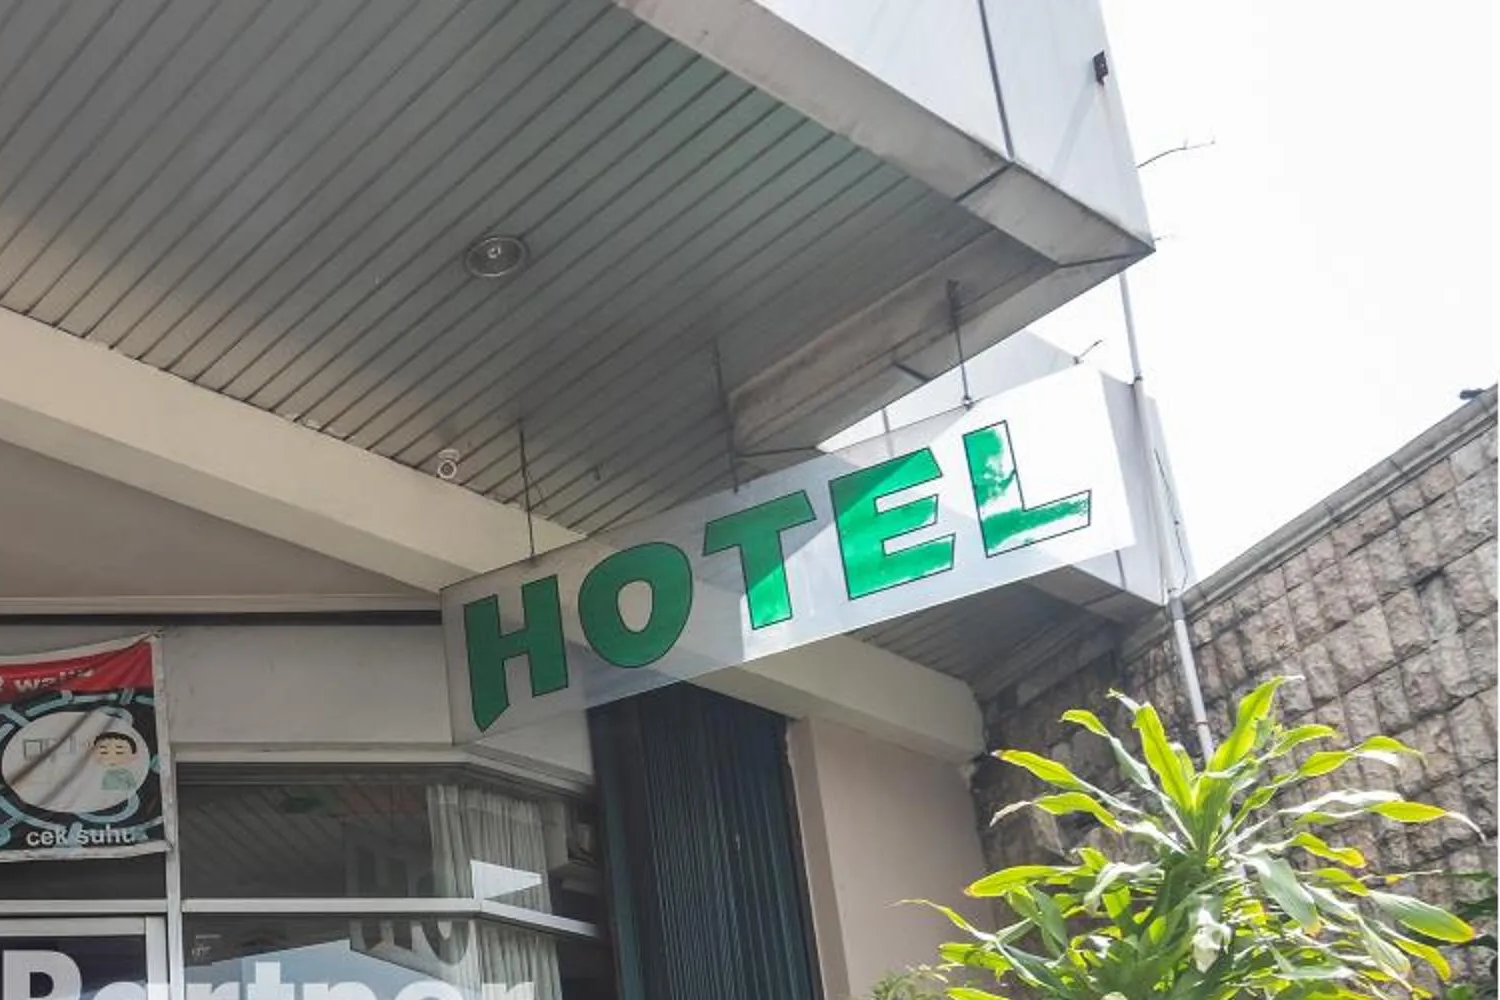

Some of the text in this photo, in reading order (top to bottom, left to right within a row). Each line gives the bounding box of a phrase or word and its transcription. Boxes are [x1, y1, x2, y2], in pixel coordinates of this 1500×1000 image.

[463, 419, 1092, 732] HOTEL
[26, 823, 136, 847] cek suhu
